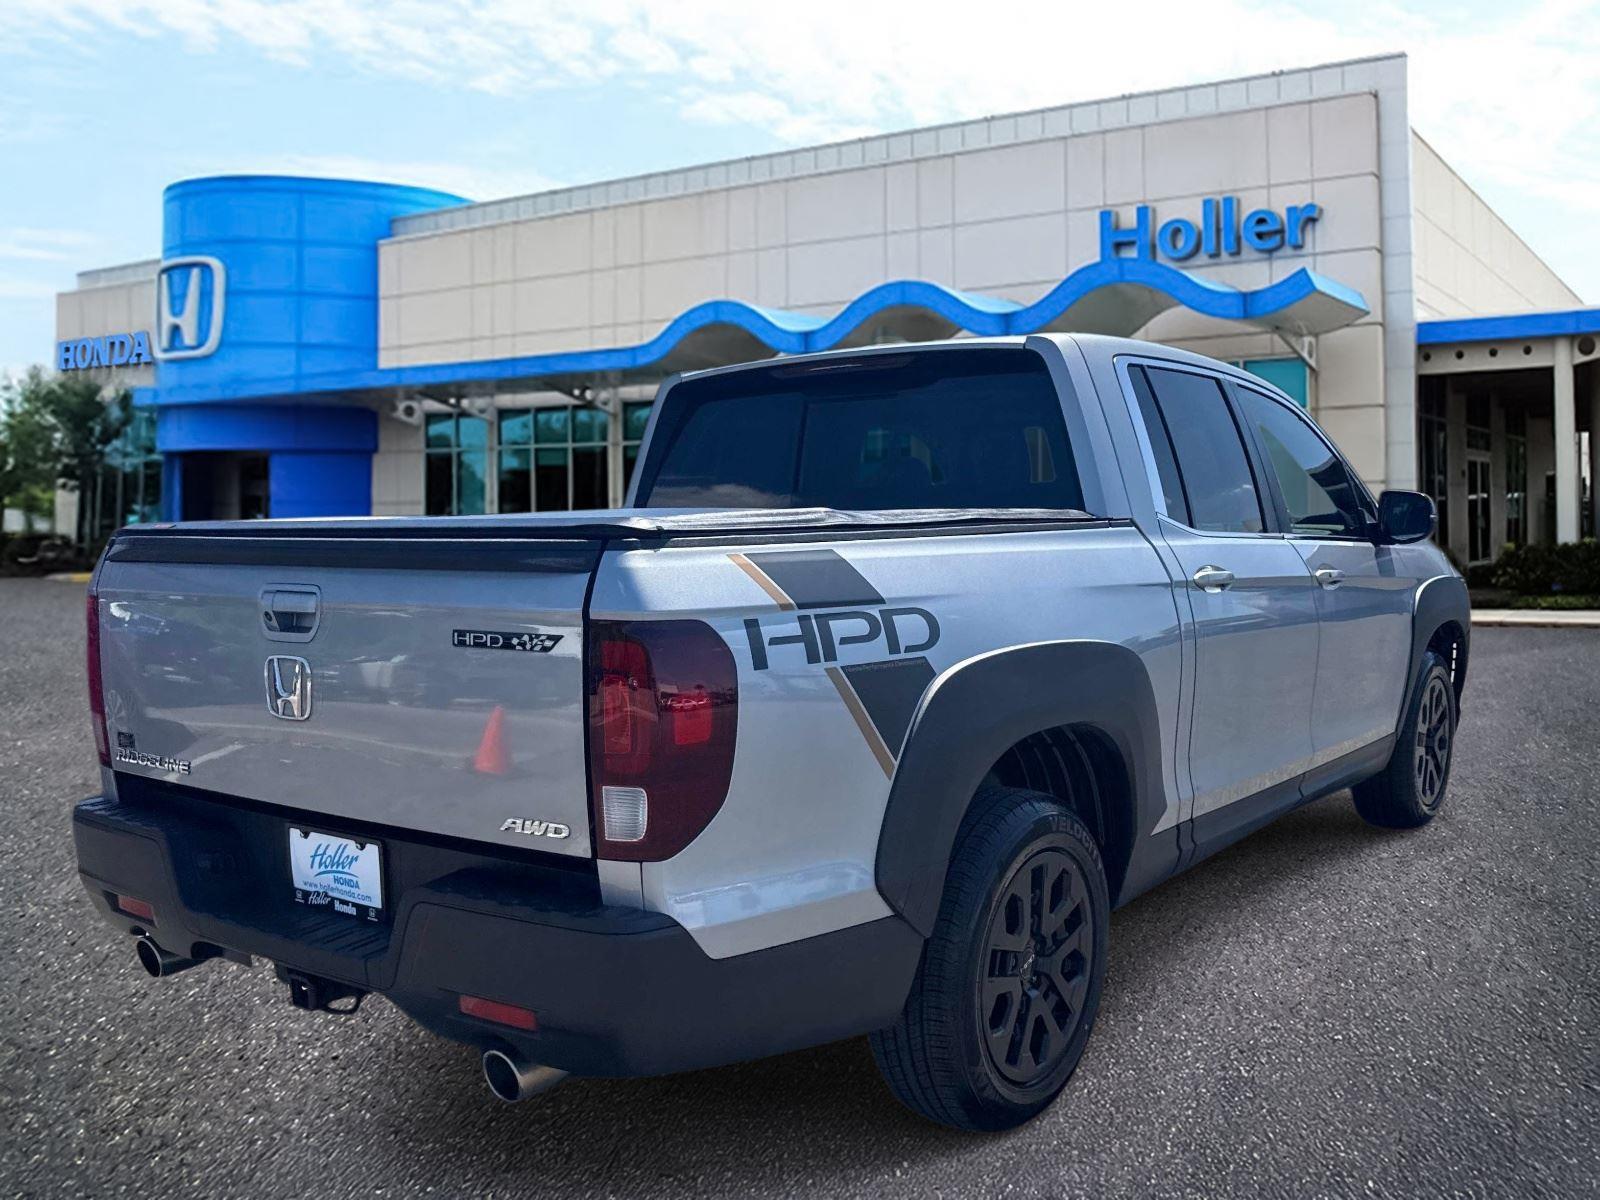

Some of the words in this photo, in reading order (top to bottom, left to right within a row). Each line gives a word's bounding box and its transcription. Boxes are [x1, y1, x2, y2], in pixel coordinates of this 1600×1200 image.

[1099, 196, 1322, 260] Holler
[58, 331, 152, 370] HONDA
[454, 632, 503, 647] HPD
[743, 607, 941, 671] HPD
[116, 747, 192, 775] RIDGELINE
[500, 818, 570, 839] AWD
[310, 843, 359, 870] Holler
[333, 875, 360, 889] HONDA
[308, 891, 332, 905] Holler
[334, 900, 357, 916] Honda
